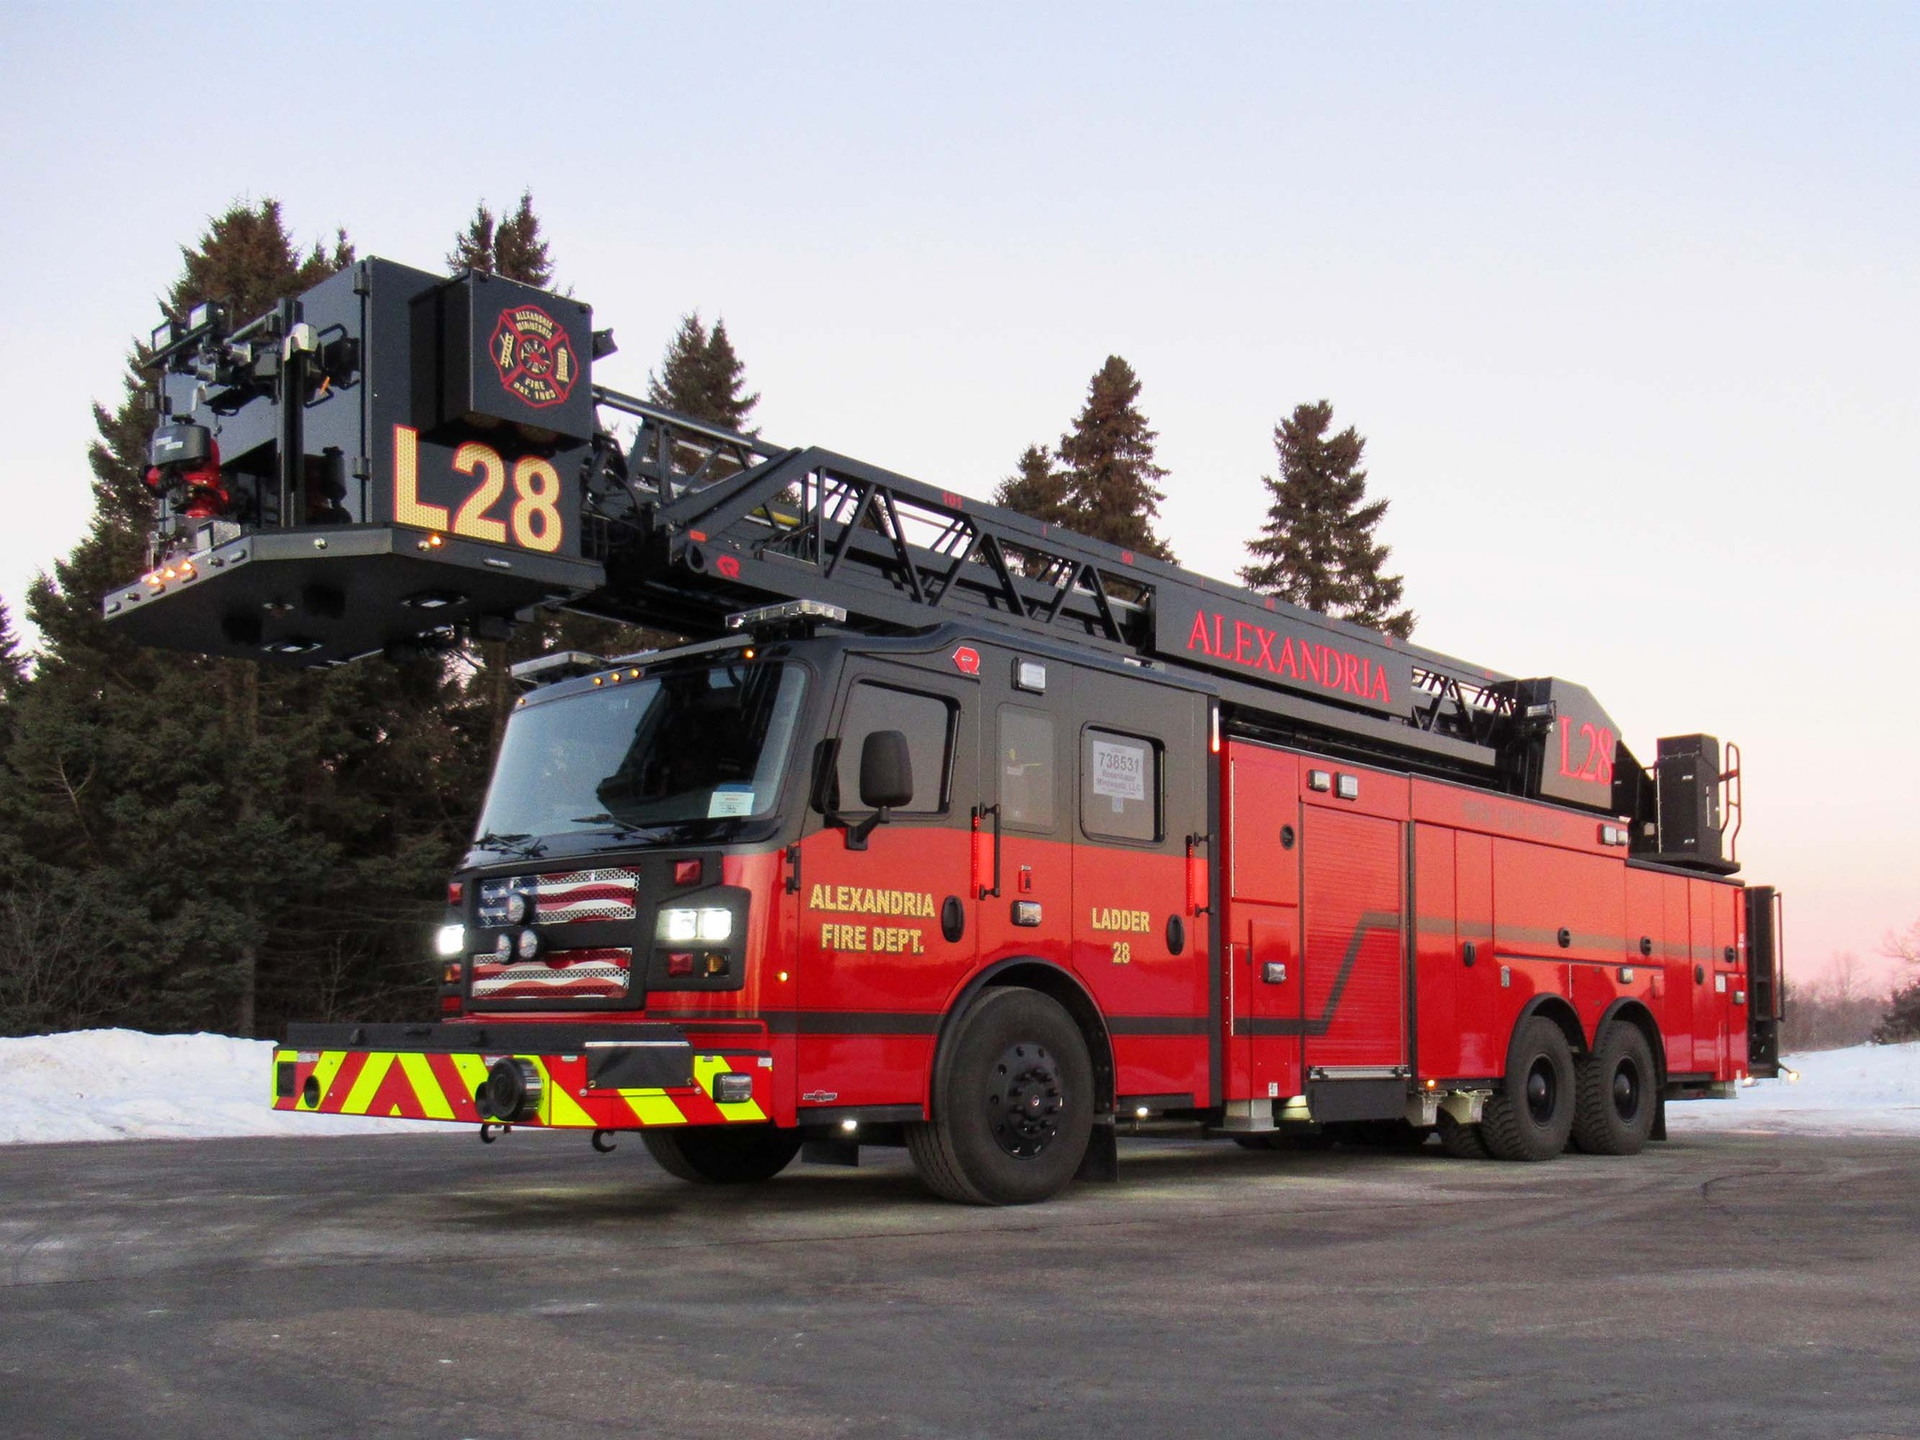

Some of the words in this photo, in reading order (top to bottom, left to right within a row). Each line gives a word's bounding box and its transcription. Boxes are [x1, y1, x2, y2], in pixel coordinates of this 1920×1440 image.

[515, 311, 553, 330] ALEXANDRIA
[525, 377, 546, 390] FIRE
[393, 423, 563, 553] L28
[1187, 609, 1391, 703] ALEXANDRIA
[1099, 752, 1140, 774] 738531
[1558, 715, 1615, 786] L28
[809, 883, 936, 918] ALEXANDRIA
[1091, 907, 1151, 933] LADDER
[821, 923, 867, 951] FIRE
[872, 926, 925, 955] DEPT.
[1112, 941, 1131, 964] 28
